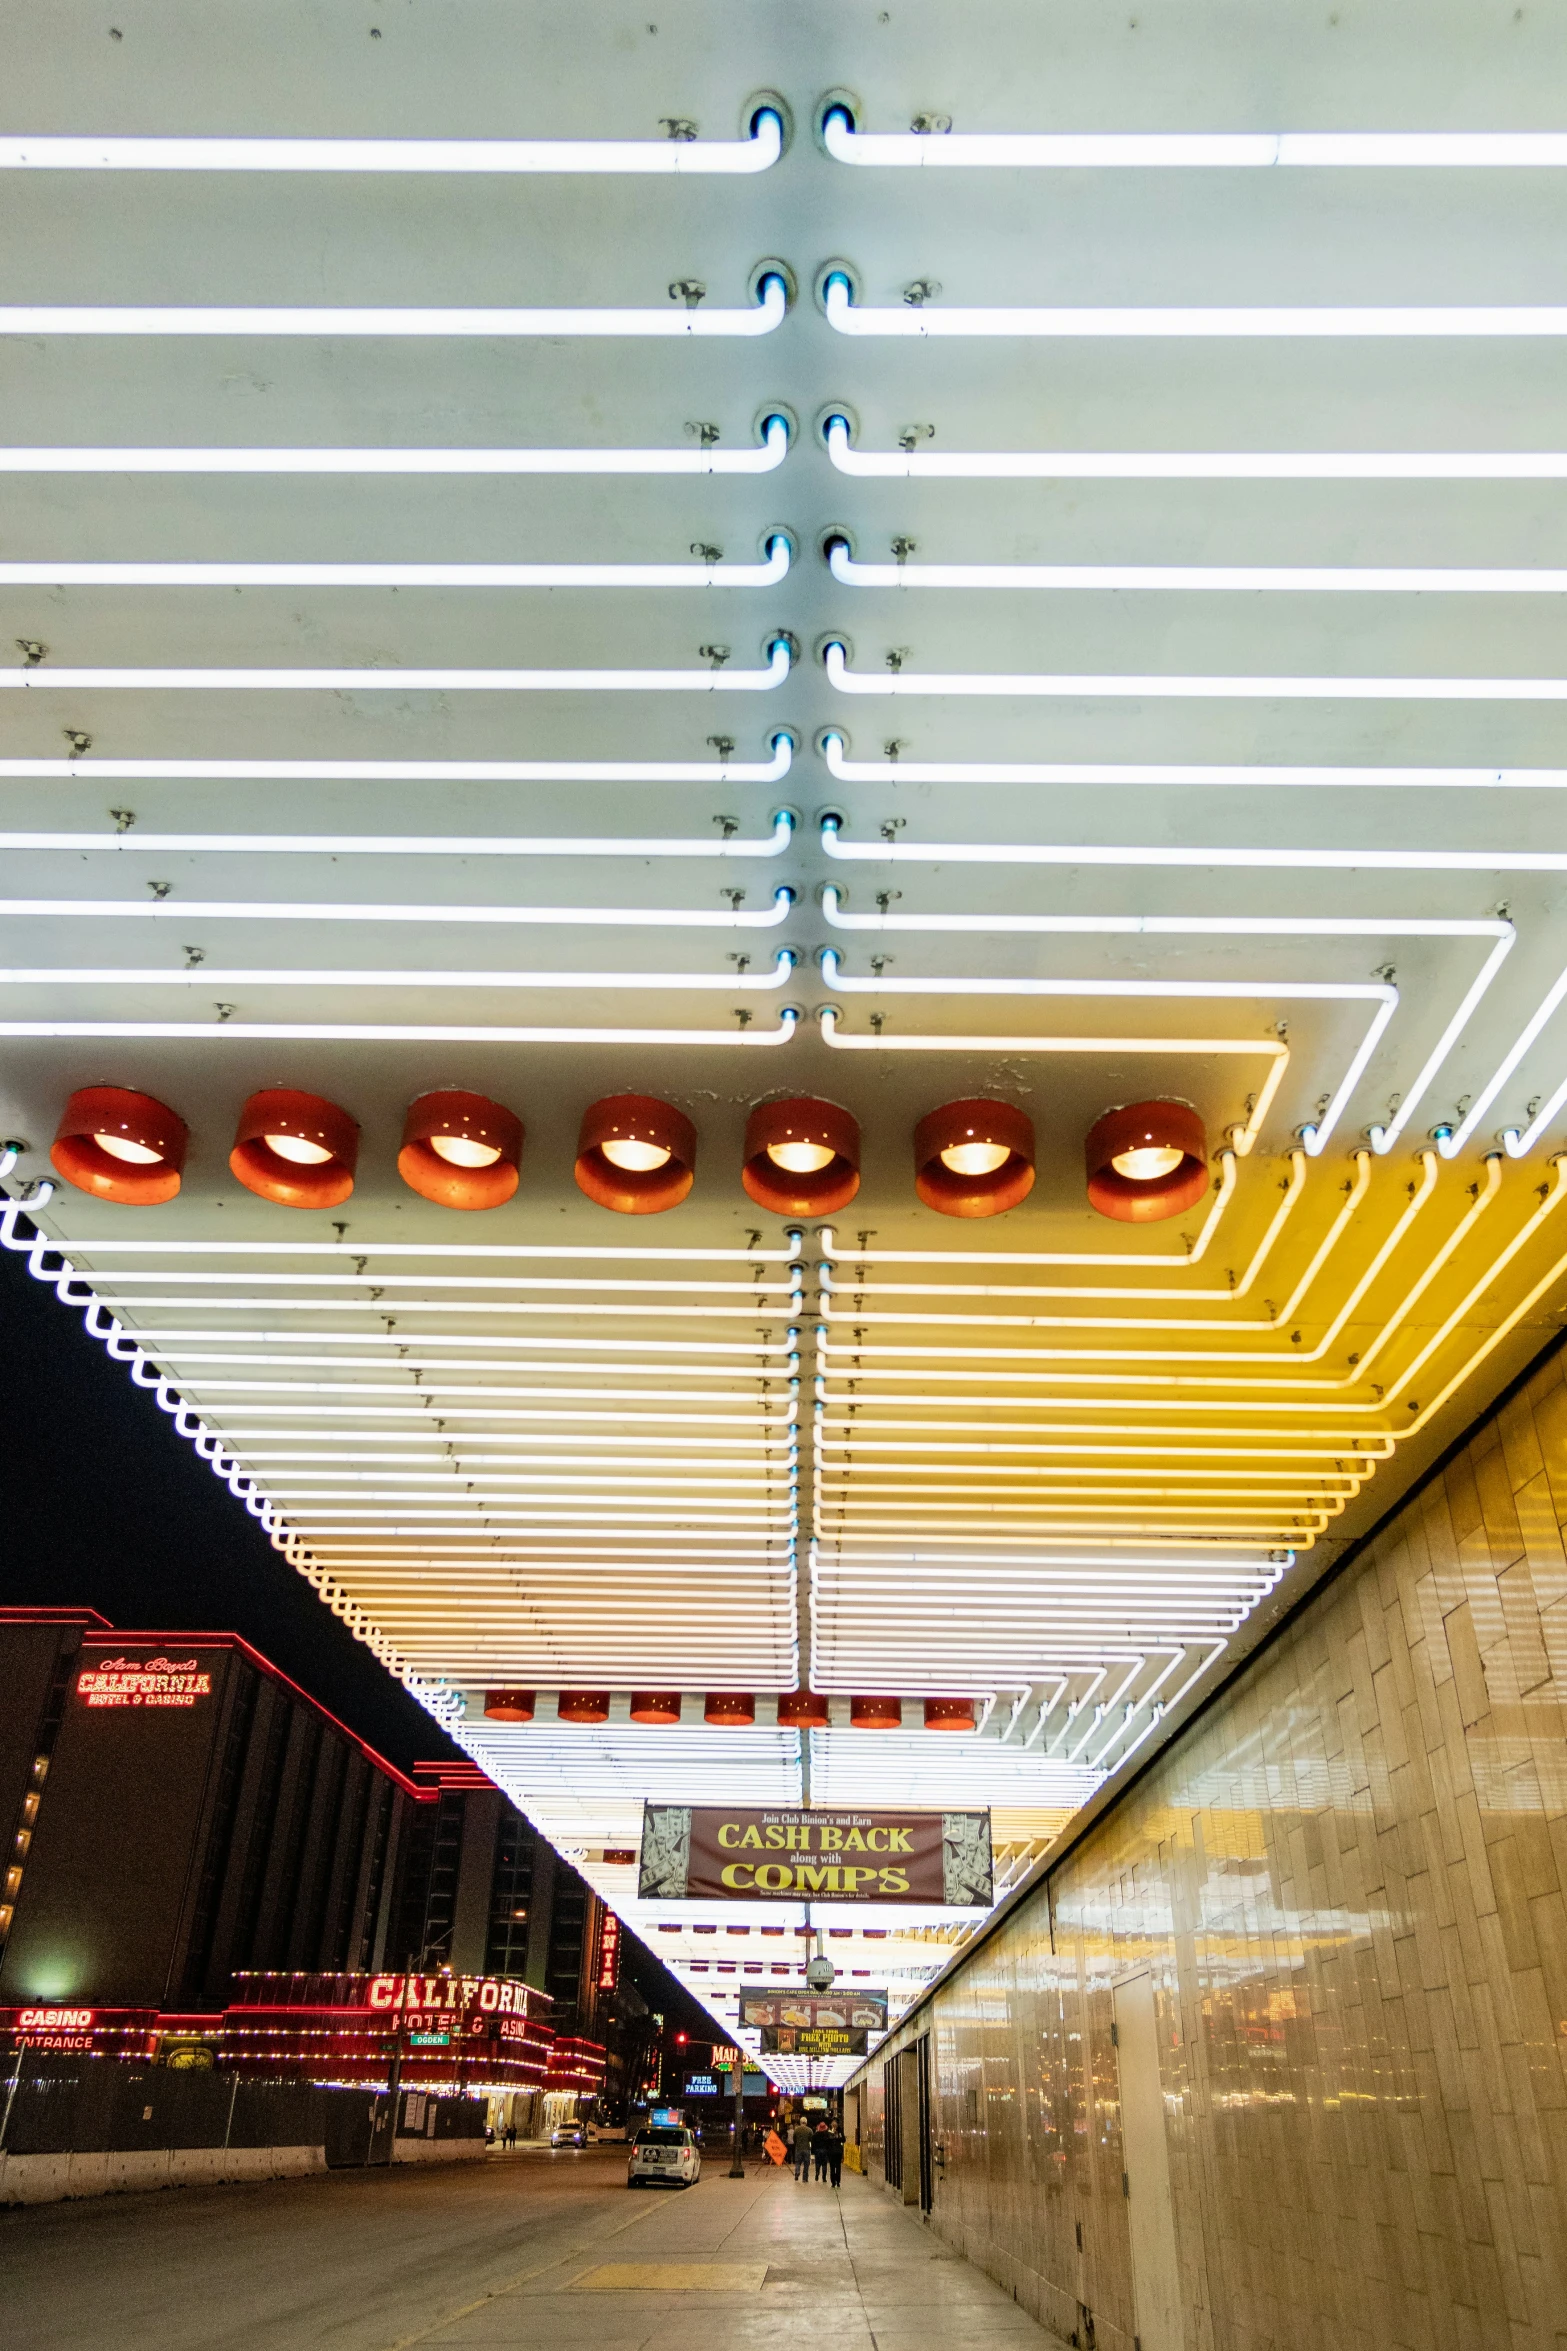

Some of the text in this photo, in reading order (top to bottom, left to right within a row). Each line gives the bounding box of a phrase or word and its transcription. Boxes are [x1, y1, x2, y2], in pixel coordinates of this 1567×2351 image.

[100, 1657, 197, 1674] Sam Boyd's
[78, 1673, 210, 1693] CALIFORNIA
[88, 1693, 194, 1705] HOTEL & CASINO
[762, 1813, 872, 1826] Join Club Binion's and Earn
[717, 1823, 915, 1852] CASH BACK
[790, 1852, 842, 1864] along with
[721, 1863, 910, 1893] COMPS
[370, 1978, 528, 2018] CALIFORNIA
[20, 2010, 92, 2026] CASINO
[472, 2016, 484, 2034] &
[500, 2020, 525, 2037] ASINO
[15, 2036, 93, 2048] ENTRANCE
[417, 2036, 443, 2044] OGDEN
[801, 2032, 849, 2043] FREE PHOTO
[691, 2076, 712, 2084] FREE
[685, 2084, 717, 2093] PARKING
